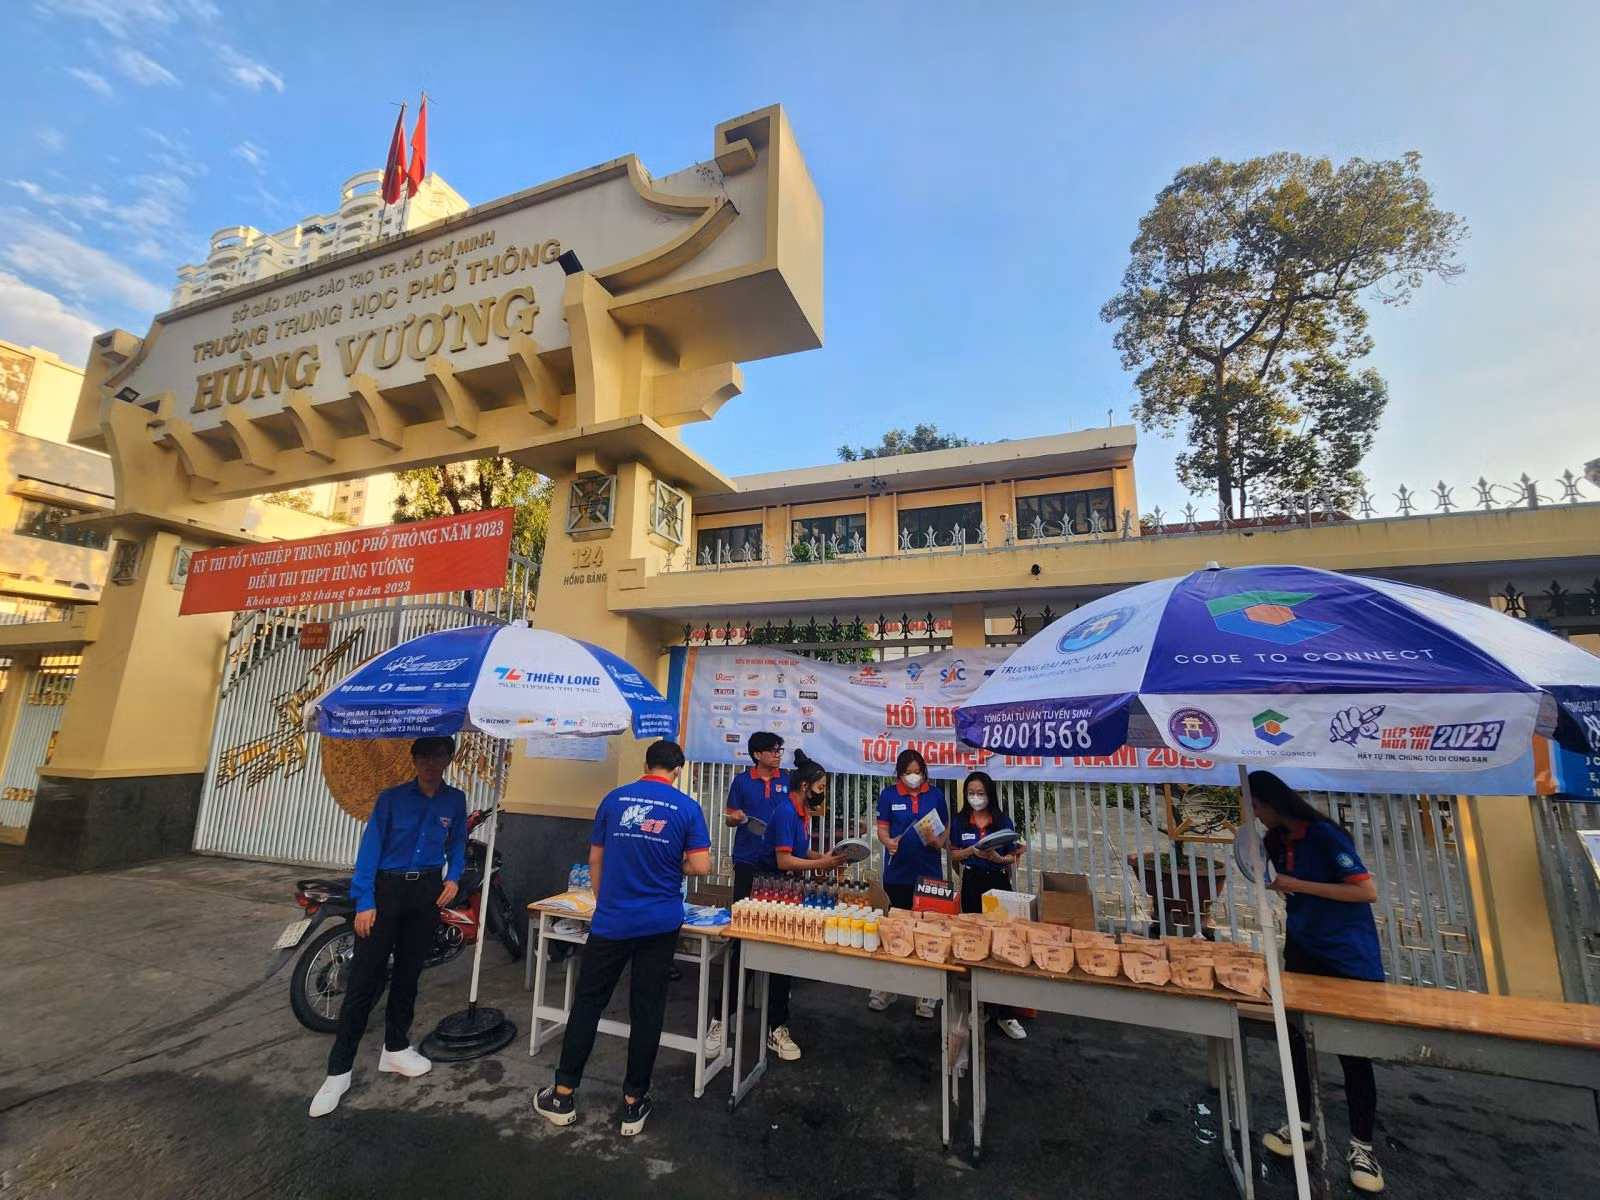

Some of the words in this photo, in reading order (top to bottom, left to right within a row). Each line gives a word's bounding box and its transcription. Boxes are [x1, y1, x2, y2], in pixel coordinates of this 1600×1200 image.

[231, 304, 249, 323] SỞ
[251, 296, 280, 318] GIÁO
[349, 271, 374, 289] TẠO
[379, 263, 399, 279] TP.
[402, 248, 423, 272] HỒ
[428, 240, 454, 265] CHÍ
[456, 230, 496, 256] MINH
[193, 324, 269, 363] TRƯỜNG
[275, 303, 343, 340] TRUNG
[349, 286, 398, 319] HỌC
[406, 259, 457, 303] PHỔ
[466, 239, 561, 285] THÔNG
[190, 344, 321, 414] HÙNG
[336, 285, 540, 377] VƯƠNG
[192, 555, 208, 574] KỲ
[209, 557, 226, 572] THI
[228, 550, 250, 569] TỐT
[249, 545, 293, 567] NGHIỆP
[293, 543, 332, 561] TRUNG
[333, 540, 360, 558] HỌC
[361, 529, 389, 553] PHỔ
[391, 528, 438, 549] THÔNG
[439, 522, 472, 543] NĂM
[474, 520, 504, 539] 2023
[572, 545, 604, 569] 124
[247, 568, 277, 590] ĐIỂM
[278, 572, 298, 587] THI
[299, 567, 331, 586] THPT
[332, 561, 367, 580] HÙNG
[371, 557, 415, 576] VƯƠNG
[245, 596, 270, 607] Khóa
[273, 595, 298, 606] ngày
[299, 591, 311, 602] 28
[313, 589, 346, 601] tháng
[348, 587, 354, 597] 6
[356, 585, 381, 597] năm
[384, 581, 411, 594] 2023
[1174, 654, 1242, 664] CODE
[1253, 653, 1288, 663] TO
[1303, 649, 1435, 662] CONNECT
[526, 672, 565, 683] THIÊN
[567, 674, 600, 686] LONG
[886, 697, 916, 728] HỖ
[1071, 708, 1093, 719] SINH
[982, 719, 1092, 749] 18001568
[1409, 724, 1435, 738] SỨC
[1410, 739, 1429, 750] THI
[1432, 722, 1500, 749] 2023
[862, 731, 901, 763] TỐT
[917, 883, 952, 898] ABBEN
